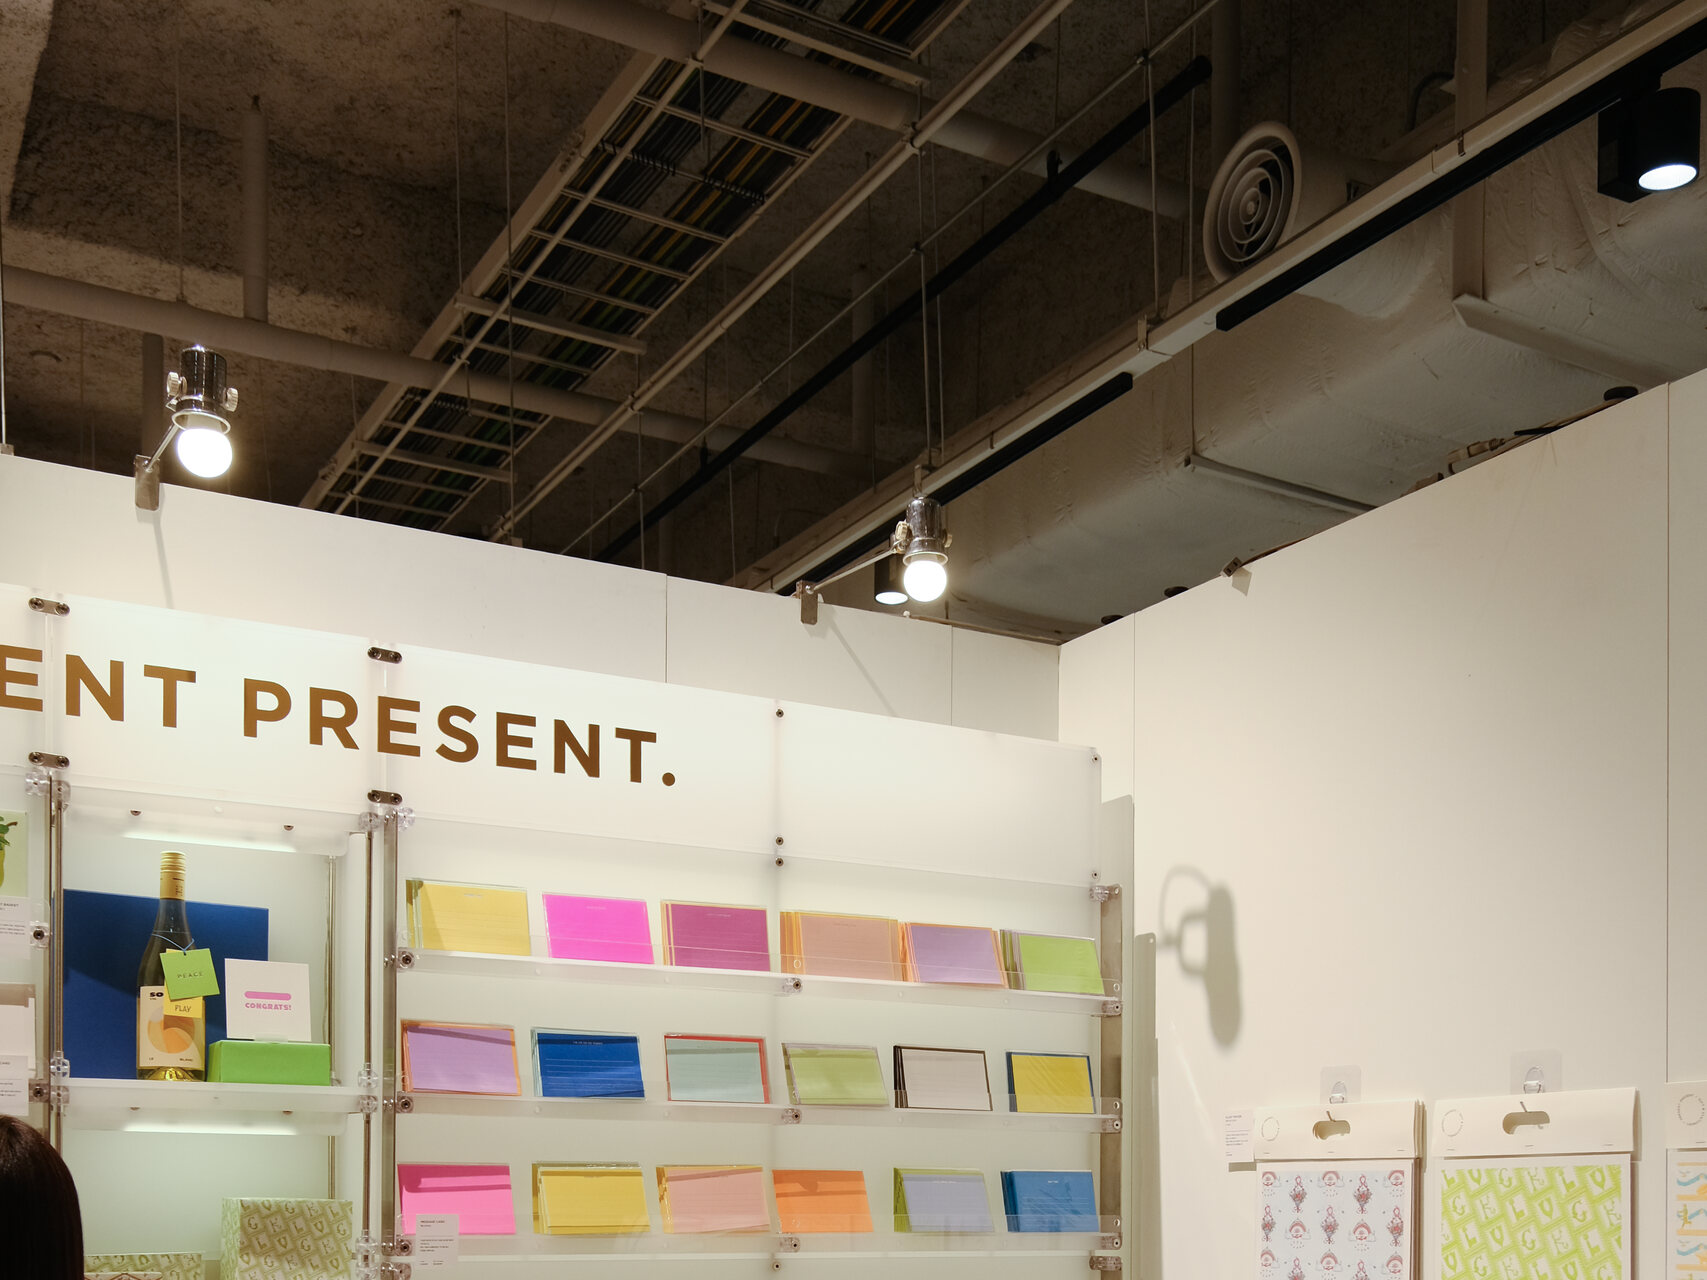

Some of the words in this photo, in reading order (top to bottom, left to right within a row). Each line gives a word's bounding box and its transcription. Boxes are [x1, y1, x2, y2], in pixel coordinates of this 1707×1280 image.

[0, 645, 197, 728] ENT
[243, 678, 676, 786] PRESENT.
[177, 971, 204, 979] PEACE
[174, 1004, 192, 1013] PLAY
[244, 1002, 292, 1011] CONGRATS!
